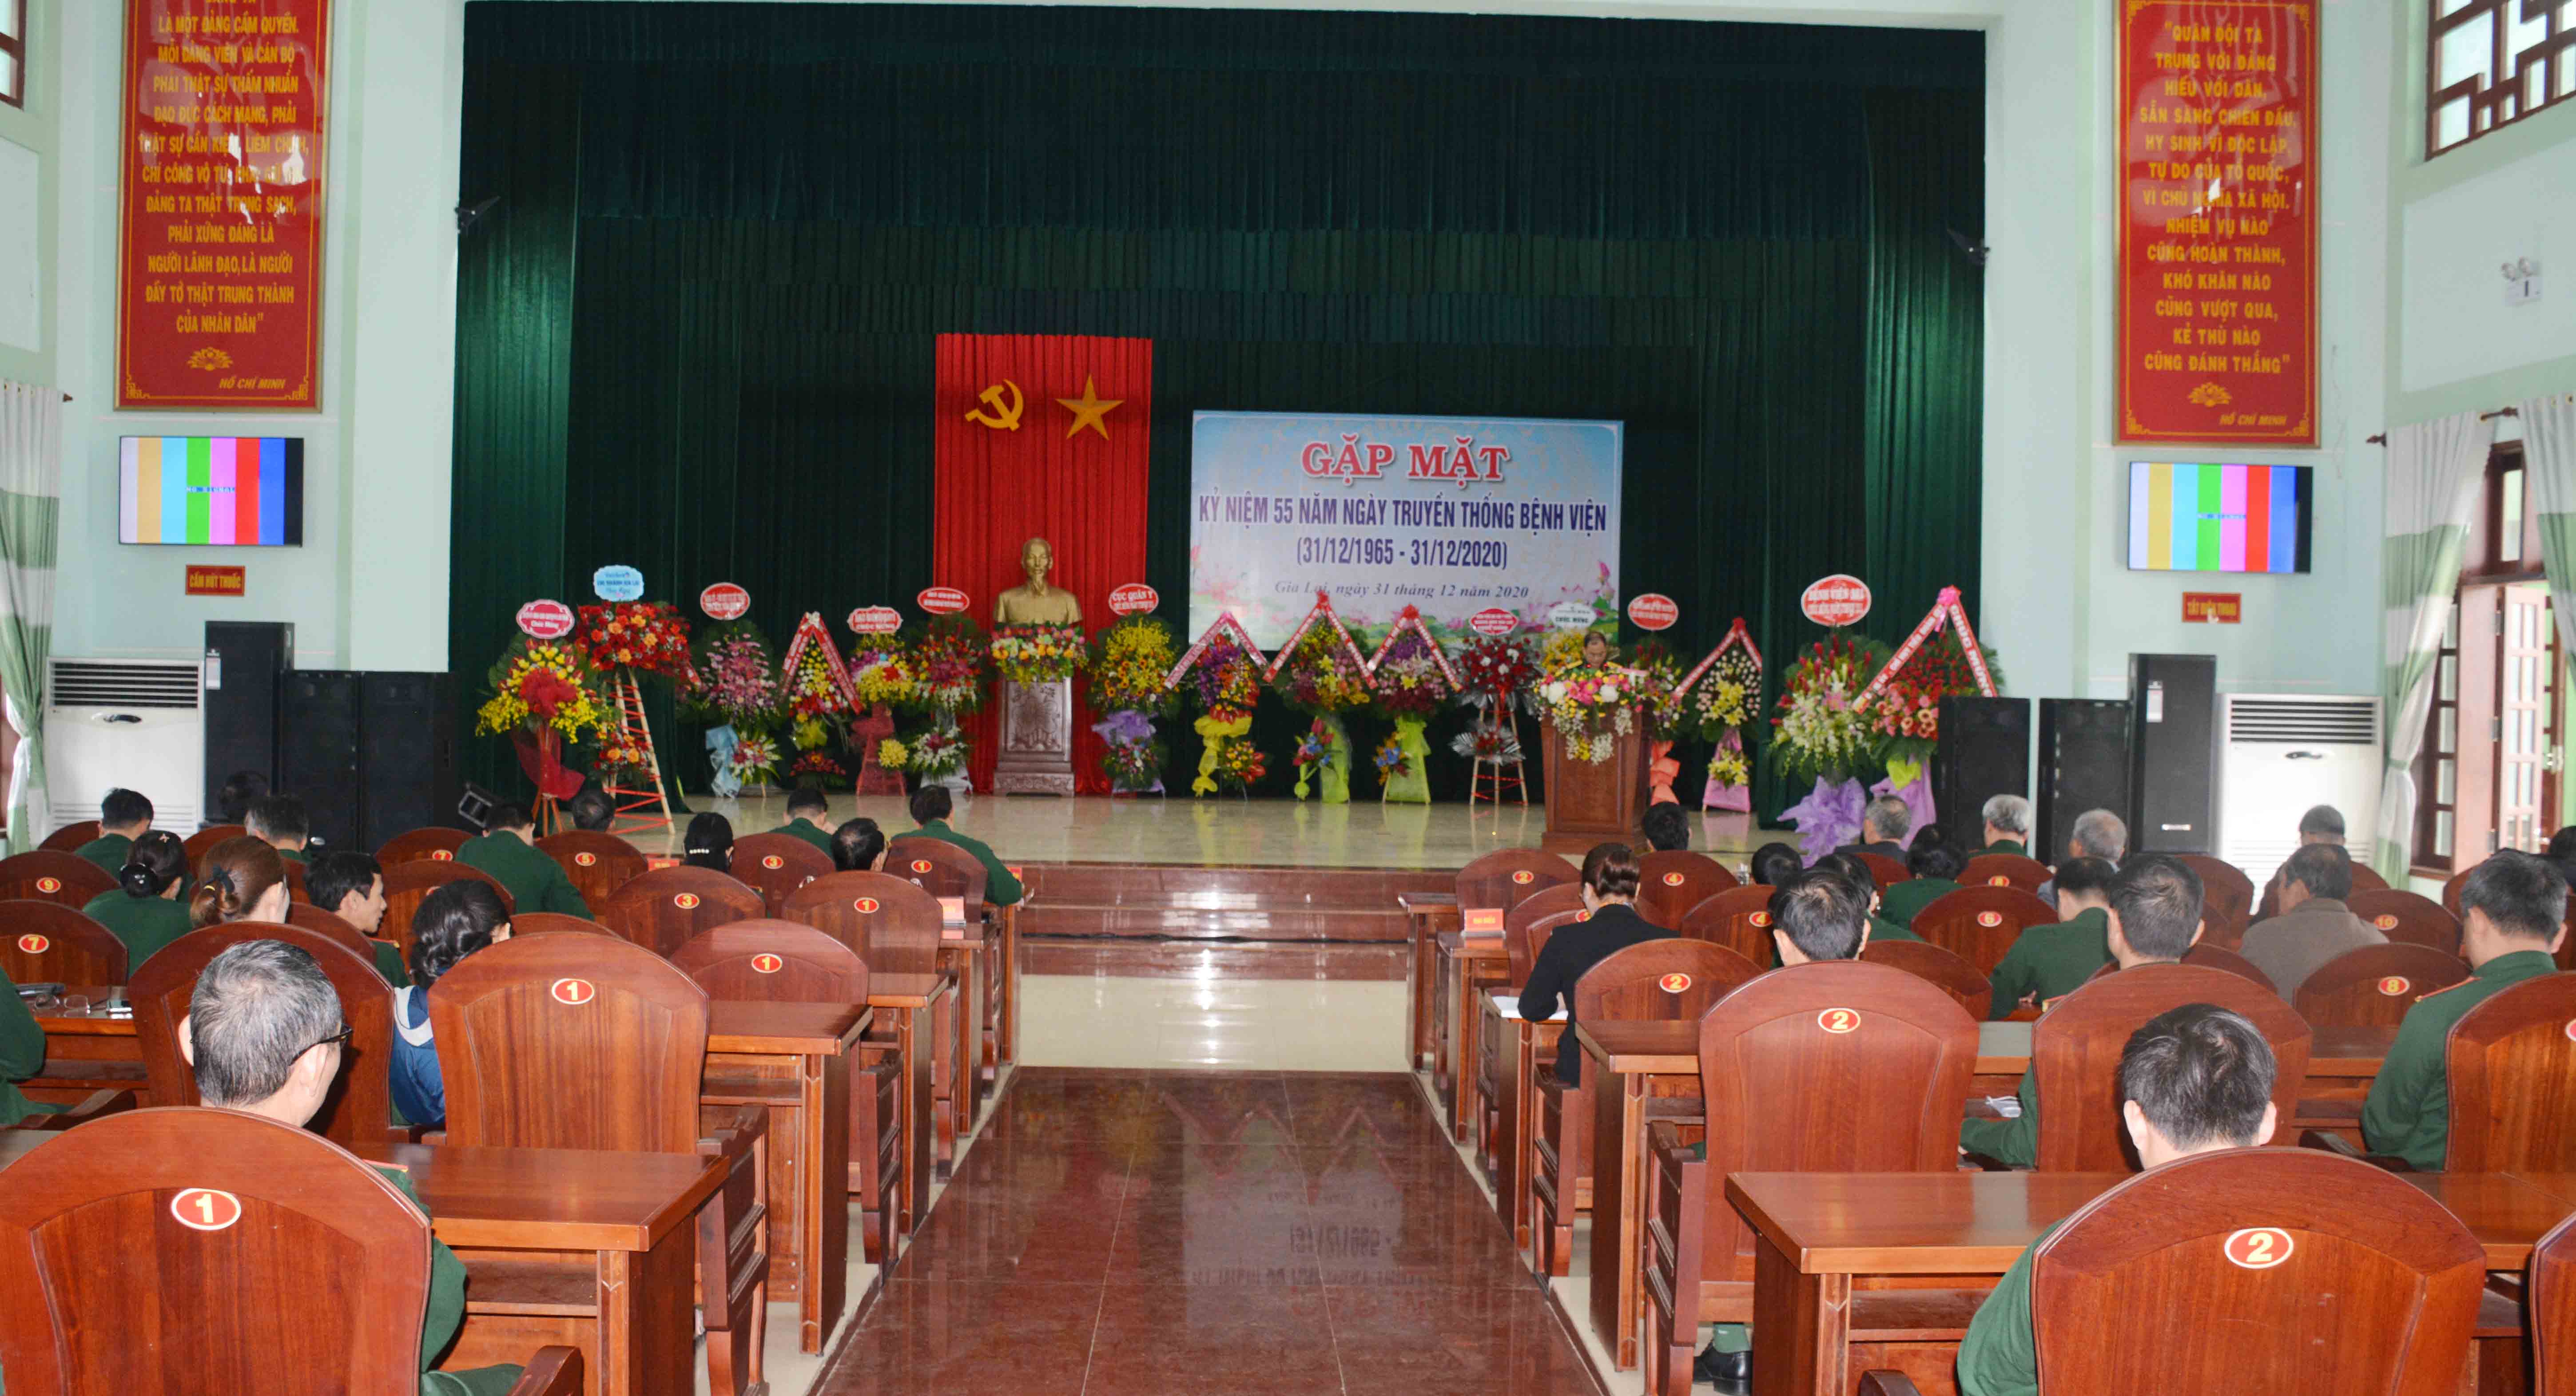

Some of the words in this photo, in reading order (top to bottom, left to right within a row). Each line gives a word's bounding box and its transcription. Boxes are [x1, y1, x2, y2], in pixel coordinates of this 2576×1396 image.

[159, 13, 172, 33] LÀ
[176, 12, 198, 37] MỘT
[202, 10, 231, 33] ĐẢNG
[2216, 23, 2238, 46] ĐỘI
[2246, 27, 2263, 43] TA
[183, 39, 210, 63] ĐẢNG
[242, 42, 254, 63] VÀ
[257, 42, 277, 63] CÁN
[2155, 53, 2201, 69] TRUNG
[2206, 52, 2230, 69] VỚI
[2238, 51, 2276, 71] ĐẢNG
[233, 69, 261, 92] THẤM
[2165, 75, 2196, 96] HIẾU
[2204, 75, 2228, 97] VỚI
[154, 106, 175, 127] ĐẠO
[204, 102, 231, 123] CÁCH
[272, 99, 296, 123] PHẢI
[2174, 105, 2212, 123] SÀNG
[2219, 106, 2259, 125] CHIẾN
[2146, 135, 2163, 150] HY
[2171, 135, 2202, 151] SINH
[2209, 131, 2222, 152] VÌ
[2228, 135, 2255, 156] ĐỘC
[164, 163, 192, 183] CÔNG
[196, 163, 210, 183] VÔ
[2149, 160, 2167, 182] TỰ
[2172, 163, 2190, 179] DO
[2195, 157, 2220, 180] CỦA
[2226, 160, 2243, 180] TỔ
[147, 192, 174, 212] ĐẢNG
[179, 196, 192, 212] TA
[2143, 188, 2156, 206] VÌ
[2161, 185, 2188, 206] CHỦ
[2238, 189, 2255, 208] XÃ
[168, 220, 192, 242] PHẢI
[196, 222, 224, 242] XỨNG
[229, 220, 256, 242] ĐÁNG
[261, 220, 274, 242] LÀ
[2167, 216, 2210, 238] NHIỆM
[2218, 219, 2234, 239] VỤ
[2241, 216, 2268, 235] NÀO
[148, 250, 181, 273] NGƯỜI
[185, 250, 213, 273] LÃNH
[242, 252, 256, 273] LÀ
[259, 250, 292, 273] NGƯỜI
[2147, 242, 2185, 261] CŨNG
[2191, 242, 2227, 262] HOÀN
[2235, 243, 2286, 266] THÀNH,
[2163, 270, 2192, 289] KHÓ
[2198, 270, 2237, 290] KHĂN
[2242, 271, 2270, 290] NÀO
[170, 280, 185, 303] TỚ
[218, 286, 253, 303] TRUNG
[257, 282, 294, 303] THÀNH
[2156, 296, 2193, 317] CŨNG
[2201, 299, 2238, 322] VƯỢT
[2245, 302, 2278, 322] QUA,
[177, 309, 198, 333] CỦA
[201, 313, 231, 333] NHÂN
[2174, 322, 2191, 344] KẺ
[2198, 325, 2226, 345] THÙ
[2233, 326, 2260, 345] NÀO
[2145, 350, 2182, 370] CŨNG
[2189, 353, 2227, 372] ĐÁNH
[1302, 434, 1394, 485] GẶP
[1408, 437, 1510, 487] MẶT
[1200, 487, 1222, 523] KỶ
[1226, 491, 1268, 529] NIỆM
[1274, 499, 1293, 525] 55
[1299, 493, 1337, 525] NĂM
[1343, 493, 1386, 526] NGÀY
[1393, 492, 1455, 527] TRUYỀN
[1461, 492, 1514, 529] THỐNG
[1520, 497, 1564, 535] BỆNH
[1569, 499, 1606, 536] VIỆN
[1297, 538, 1393, 566] (31/12/1965
[1411, 539, 1508, 570] 31/12/2020)
[1275, 581, 1304, 594] Gia
[1337, 583, 1368, 598] ngày
[1373, 583, 1391, 595] 31
[1395, 583, 1433, 598] tháng
[1439, 584, 1455, 597] 12
[1459, 585, 1491, 598] năm
[1495, 585, 1529, 599] 2020
[581, 854, 590, 864] 5
[769, 857, 777, 867] 3
[920, 862, 924, 871] 1
[44, 880, 53, 890] 9
[1520, 872, 1528, 882] 2
[682, 895, 692, 907] 3
[863, 900, 869, 911] 1
[1757, 914, 1766, 924] 4
[1985, 914, 1994, 924] 6
[2380, 918, 2392, 927] 10
[28, 937, 39, 951] 7
[762, 957, 770, 970] 1
[567, 982, 578, 1000] 1
[1670, 976, 1681, 989] 2
[2388, 979, 2399, 992] 8
[1832, 1011, 1845, 1029] 2
[195, 1194, 213, 1223] 1
[2246, 1232, 2274, 1262] 2
